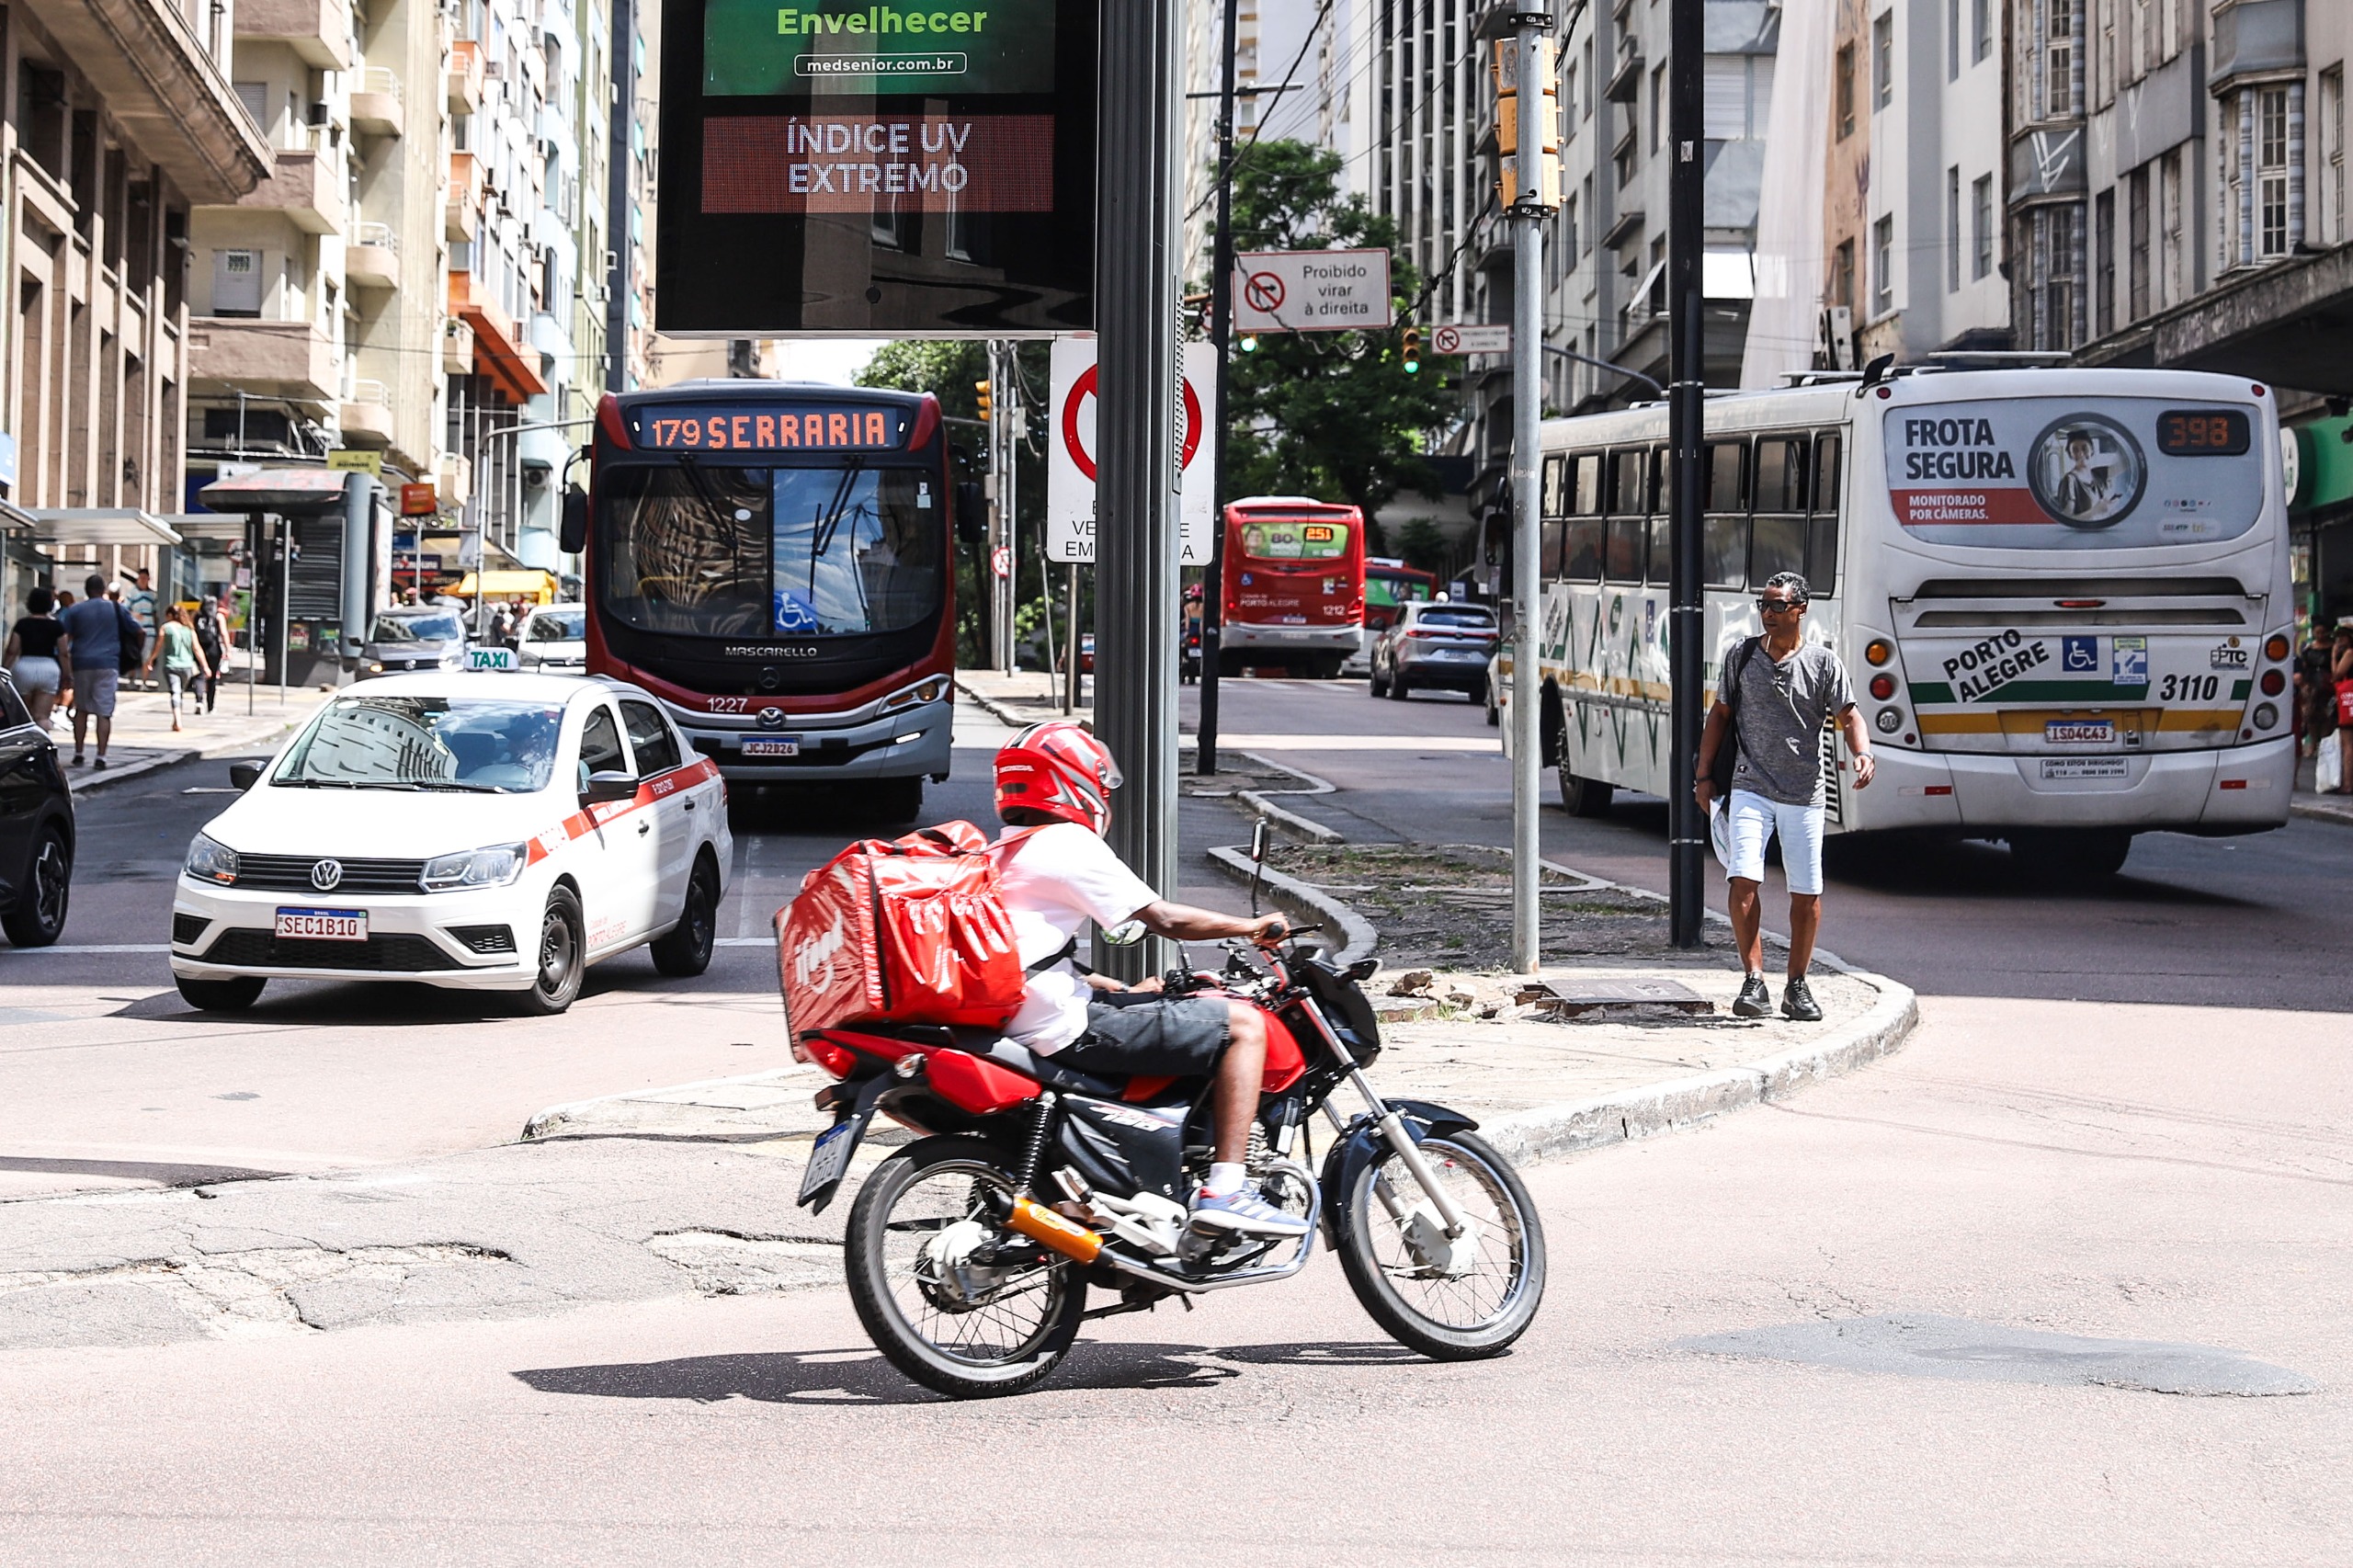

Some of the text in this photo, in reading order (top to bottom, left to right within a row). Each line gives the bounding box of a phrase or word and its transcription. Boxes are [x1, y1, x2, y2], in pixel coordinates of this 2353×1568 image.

[778, 6, 987, 34] Envelhecer
[807, 57, 953, 73] medsenior.com.br
[787, 116, 972, 154] ÍNDICE UV
[789, 163, 968, 193] EXTREMO
[1302, 265, 1367, 278] Proibido
[1317, 284, 1353, 297] virar
[1304, 301, 1369, 315] à direita
[652, 412, 885, 449] 179 SERRARIA
[1904, 418, 1995, 448] FROTA
[2167, 416, 2229, 447] 398
[1905, 451, 2016, 481] SEGURA
[1909, 494, 1985, 506] MONITORADO
[1910, 506, 1989, 520] POR CÂMERAS.
[1305, 528, 1332, 540] 251
[1323, 605, 1346, 617] 1212
[724, 646, 817, 657] MASCARELLO
[1942, 629, 2022, 681] PORTO
[2210, 649, 2248, 664] EPTC
[471, 652, 508, 668] TAXI
[1959, 641, 2050, 704] ALEGRE
[2160, 674, 2219, 701] 3110
[707, 697, 748, 713] 1227
[283, 917, 358, 937] SEC1B10
